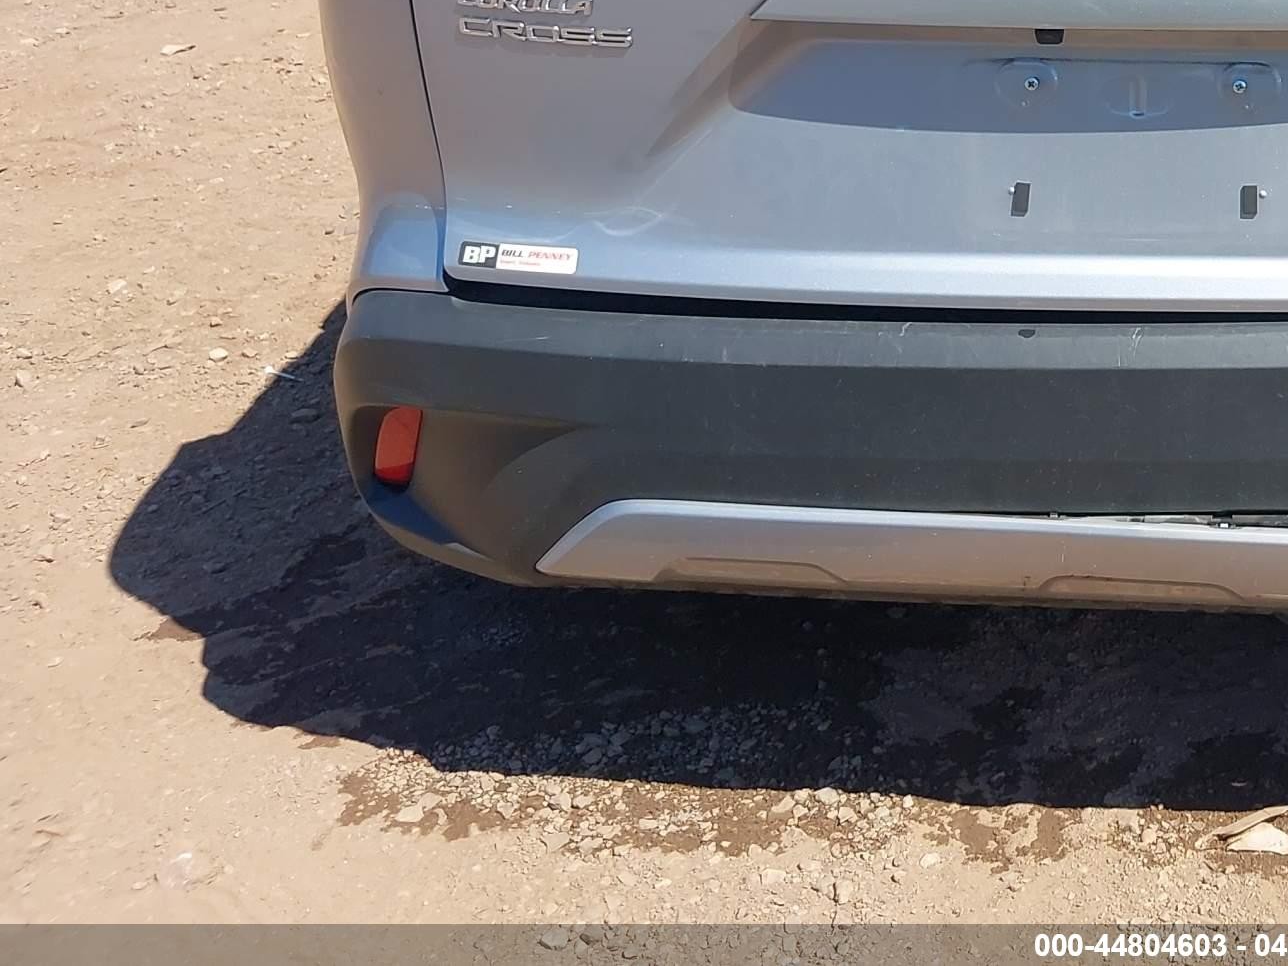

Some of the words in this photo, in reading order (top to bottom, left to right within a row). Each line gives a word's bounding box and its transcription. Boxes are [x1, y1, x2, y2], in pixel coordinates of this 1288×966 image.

[458, 17, 633, 48] CROSS
[462, 245, 497, 264] BP
[501, 249, 524, 258] BILL
[528, 251, 572, 261] PENNEY
